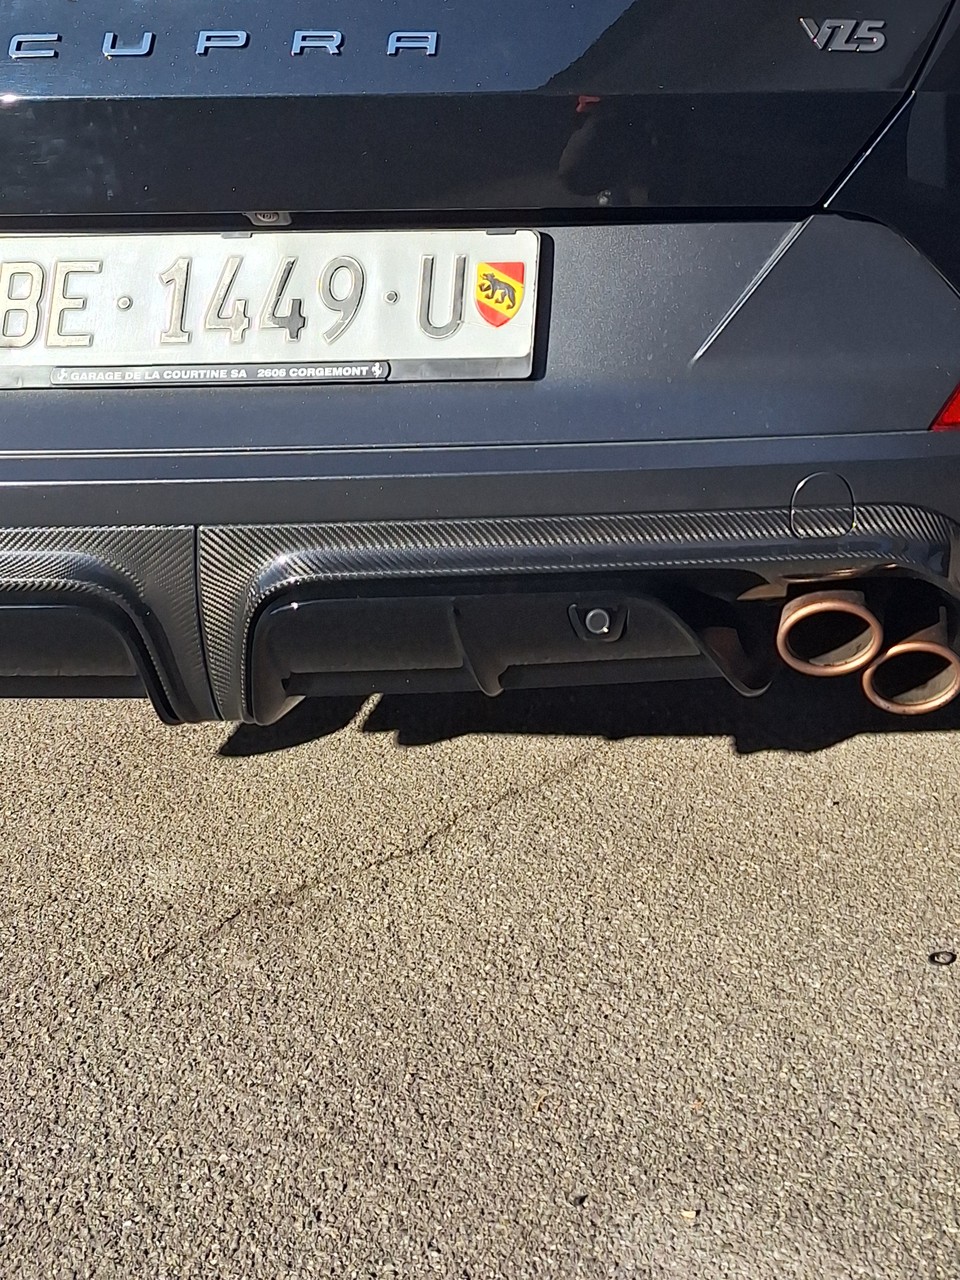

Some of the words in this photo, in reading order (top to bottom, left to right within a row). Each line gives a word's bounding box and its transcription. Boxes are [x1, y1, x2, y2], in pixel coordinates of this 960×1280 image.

[8, 29, 438, 59] CUPRA
[70, 370, 122, 381] GARAGE
[124, 370, 141, 380] DE
[144, 370, 161, 380] LA
[163, 369, 228, 380] COURTINE
[230, 368, 247, 378] SA
[288, 366, 369, 377] CORGEMONT
